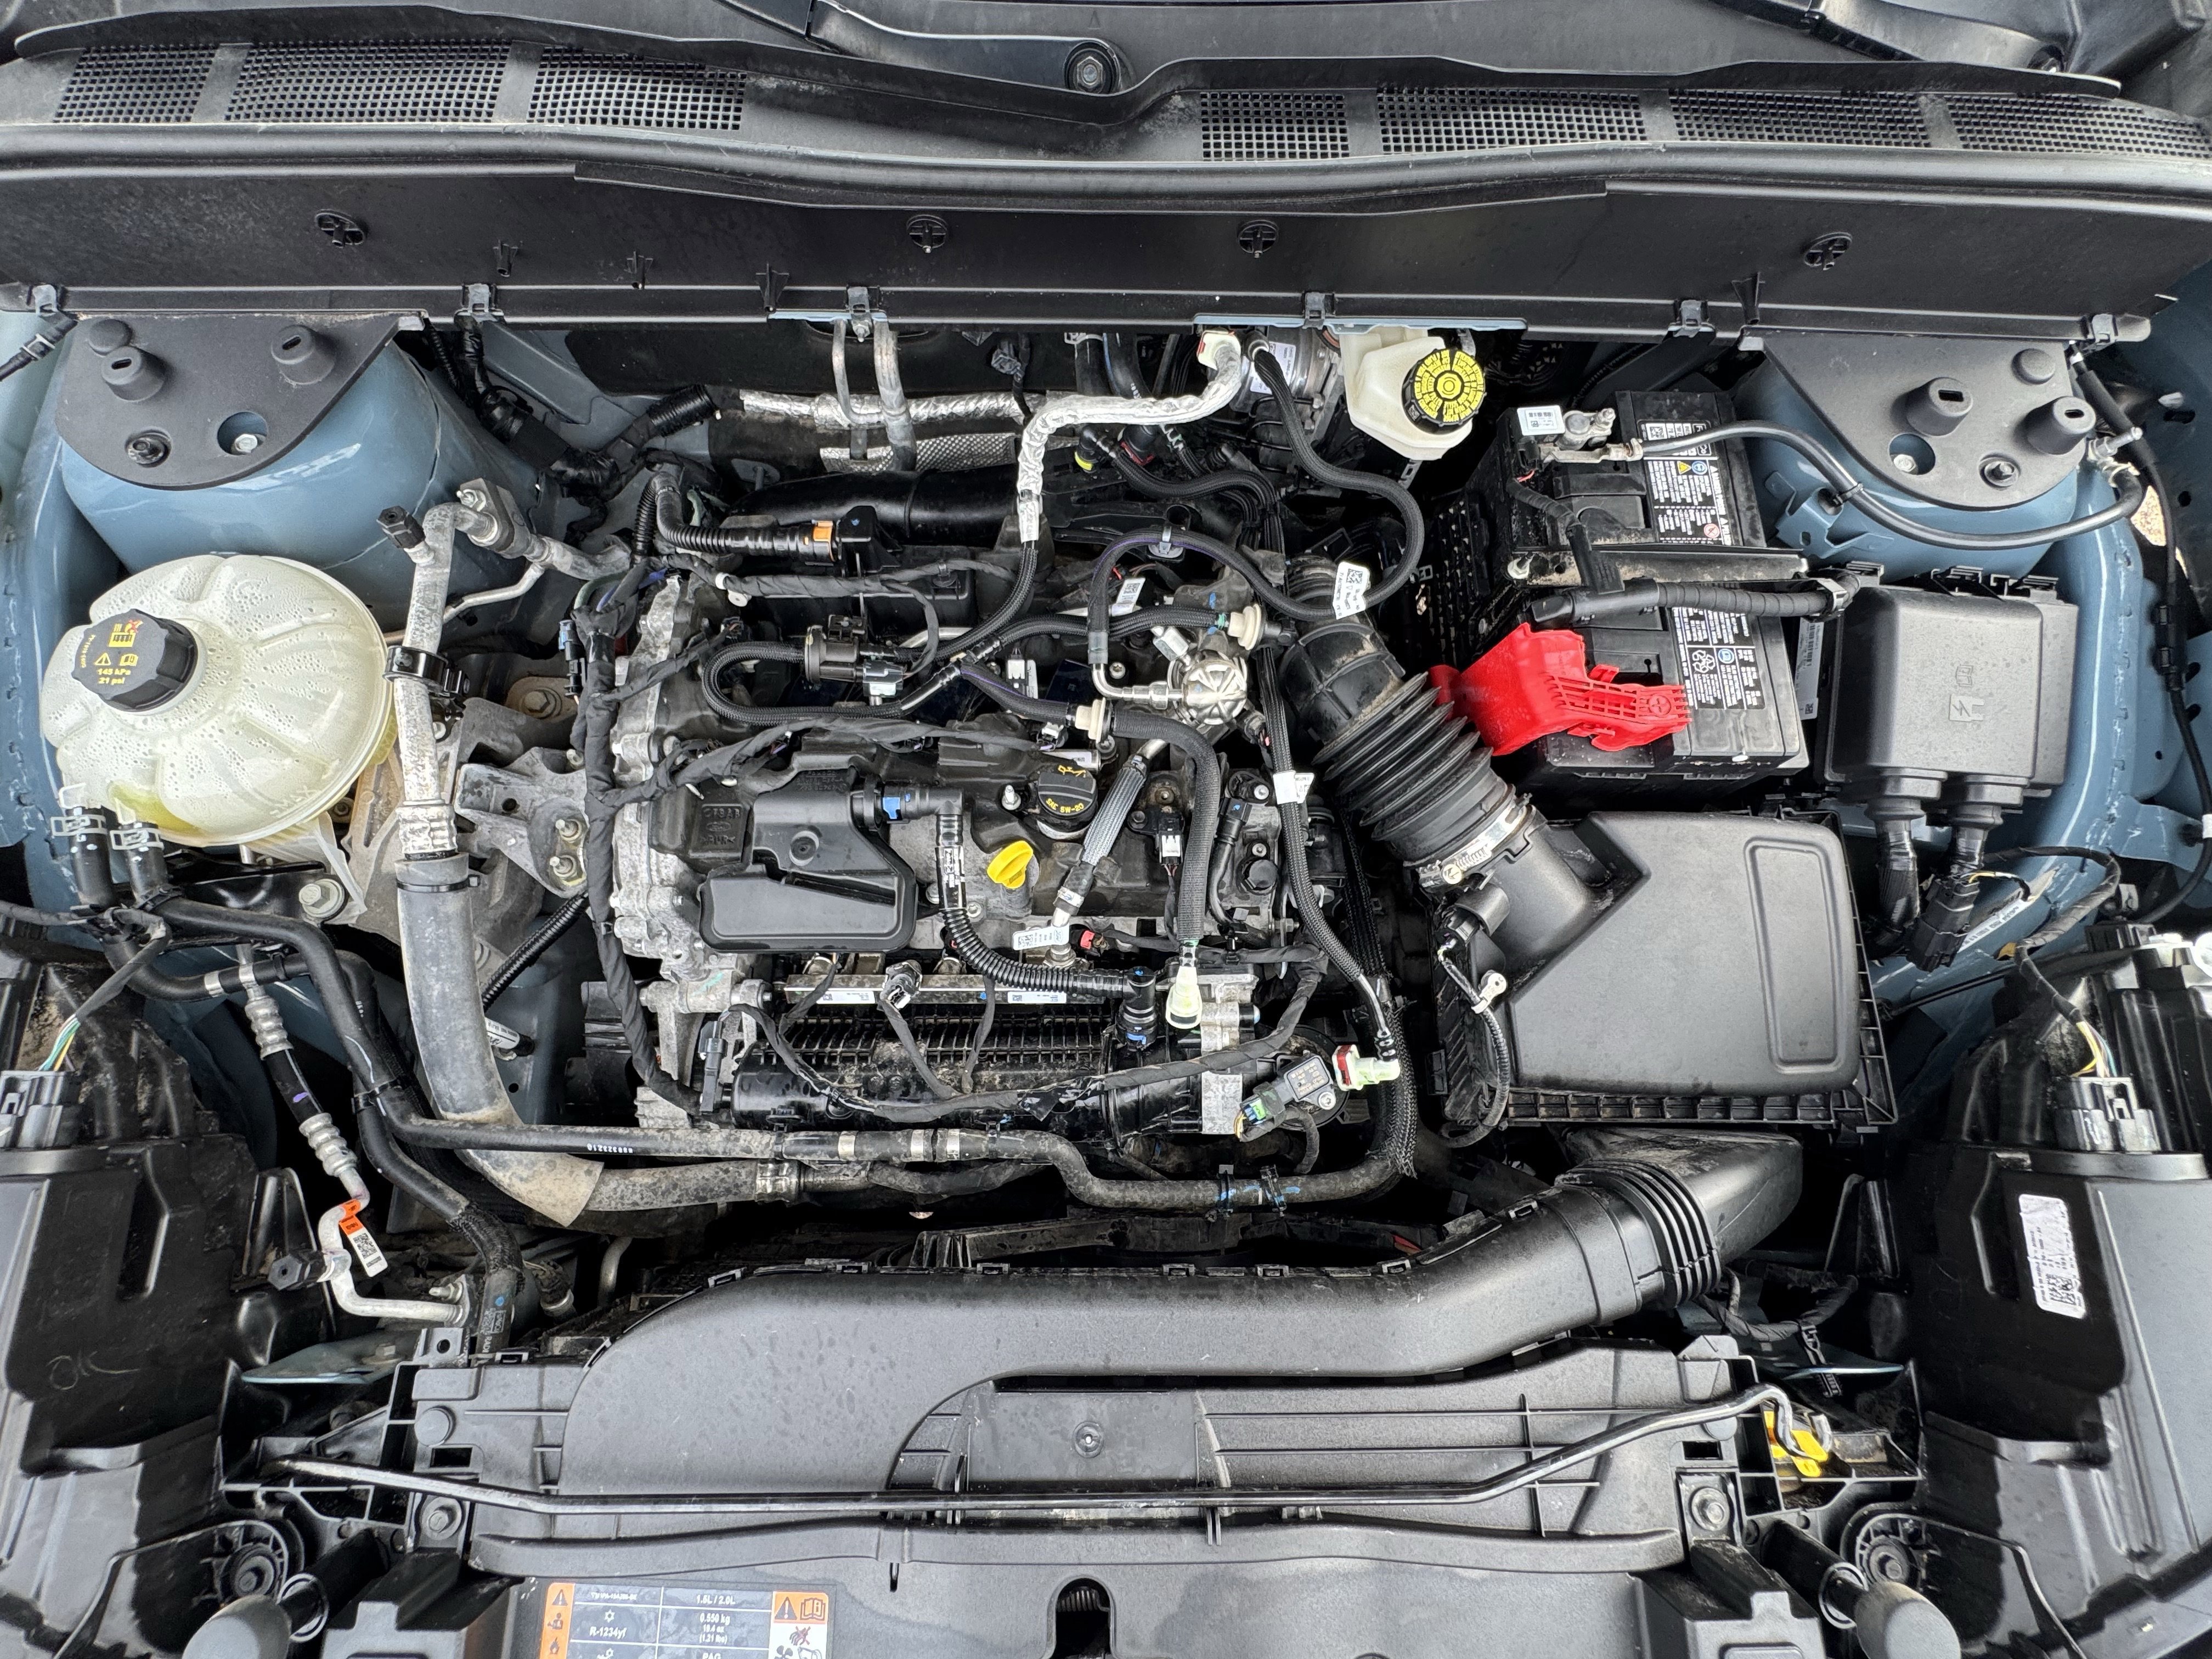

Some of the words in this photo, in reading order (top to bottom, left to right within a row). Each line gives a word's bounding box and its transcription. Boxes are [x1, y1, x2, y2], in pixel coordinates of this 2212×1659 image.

[111, 677, 126, 685] psi
[1046, 798, 1059, 810] SAE
[1060, 803, 1084, 814] 5W-20
[718, 1595, 736, 1605] 2.0L
[699, 1612, 719, 1623] 0.550
[720, 1613, 731, 1626] kg
[589, 1626, 628, 1639] R-1234yf
